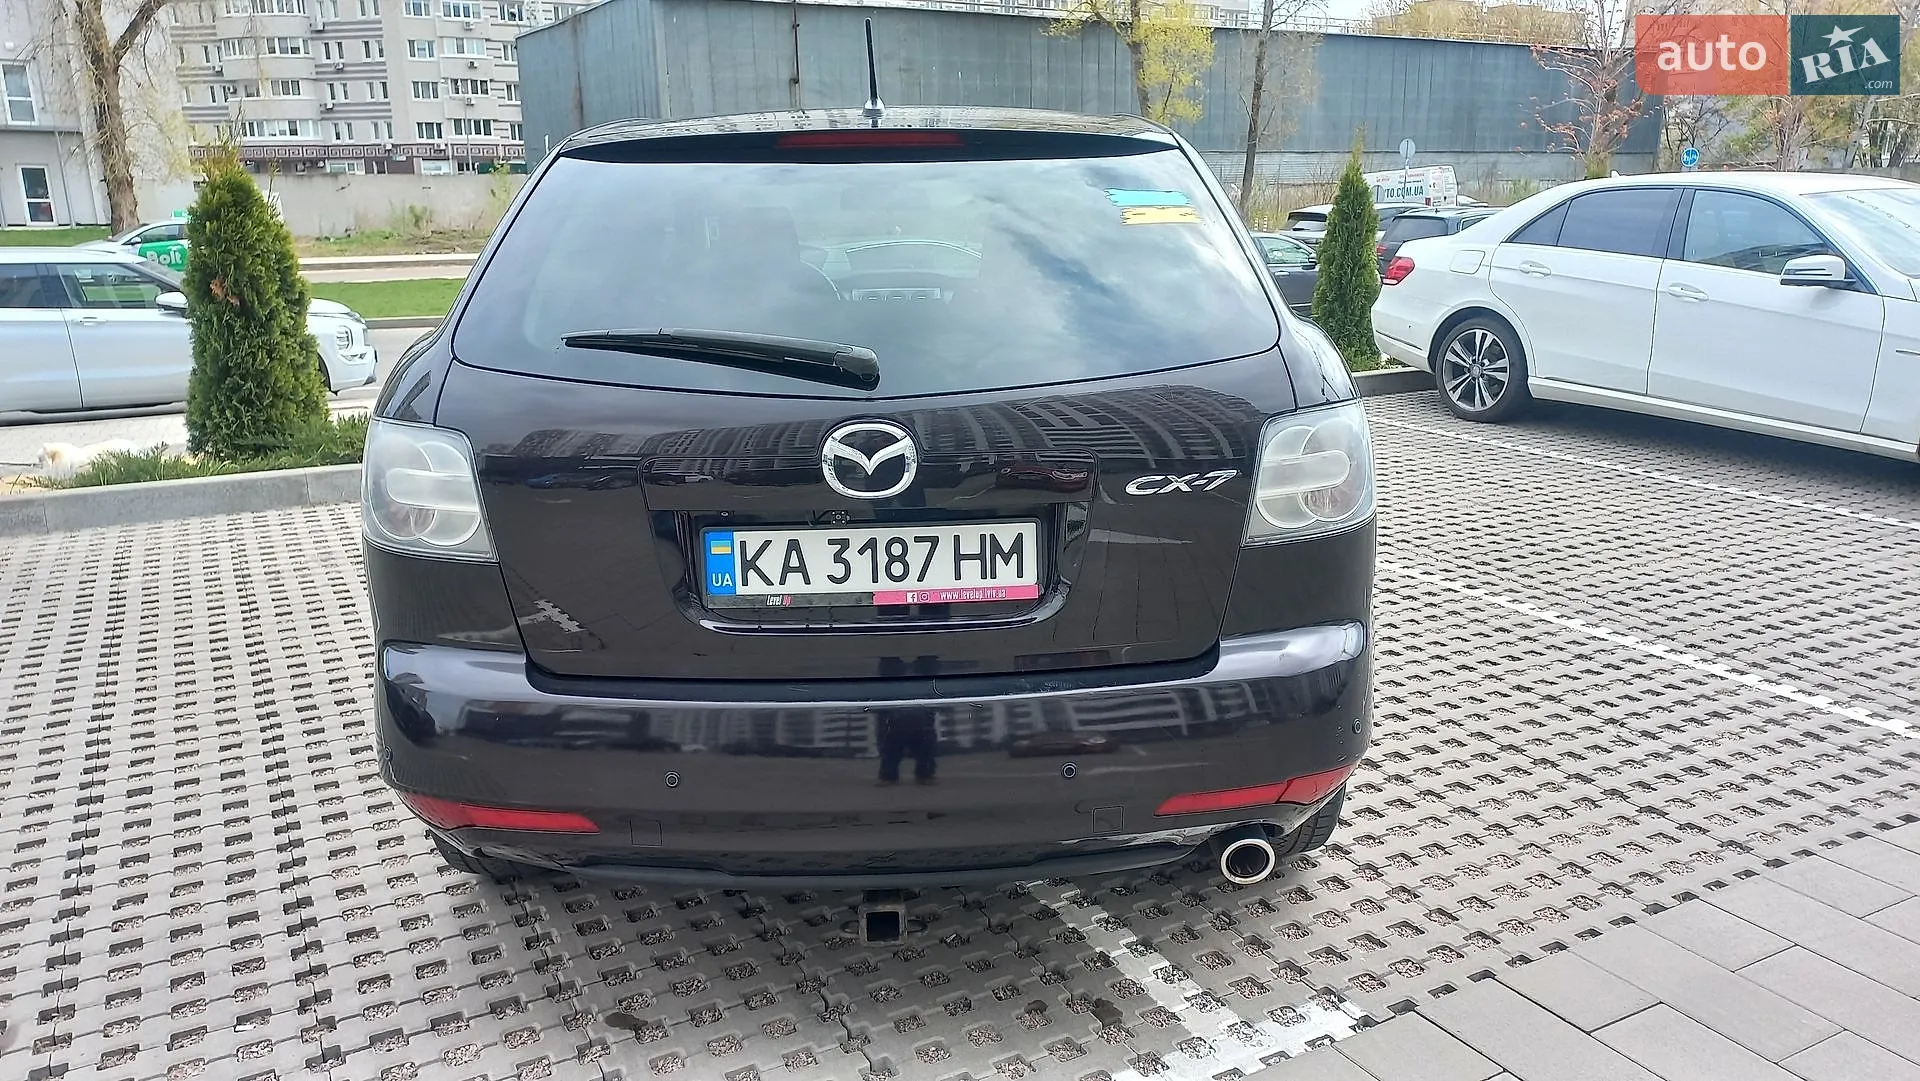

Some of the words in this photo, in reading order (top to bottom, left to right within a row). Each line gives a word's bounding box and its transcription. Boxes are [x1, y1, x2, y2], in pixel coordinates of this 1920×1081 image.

[1125, 469, 1239, 495] CX-7
[739, 538, 811, 587] KA
[826, 535, 940, 585] 3187
[953, 532, 1024, 581] HM
[712, 573, 733, 587] UA
